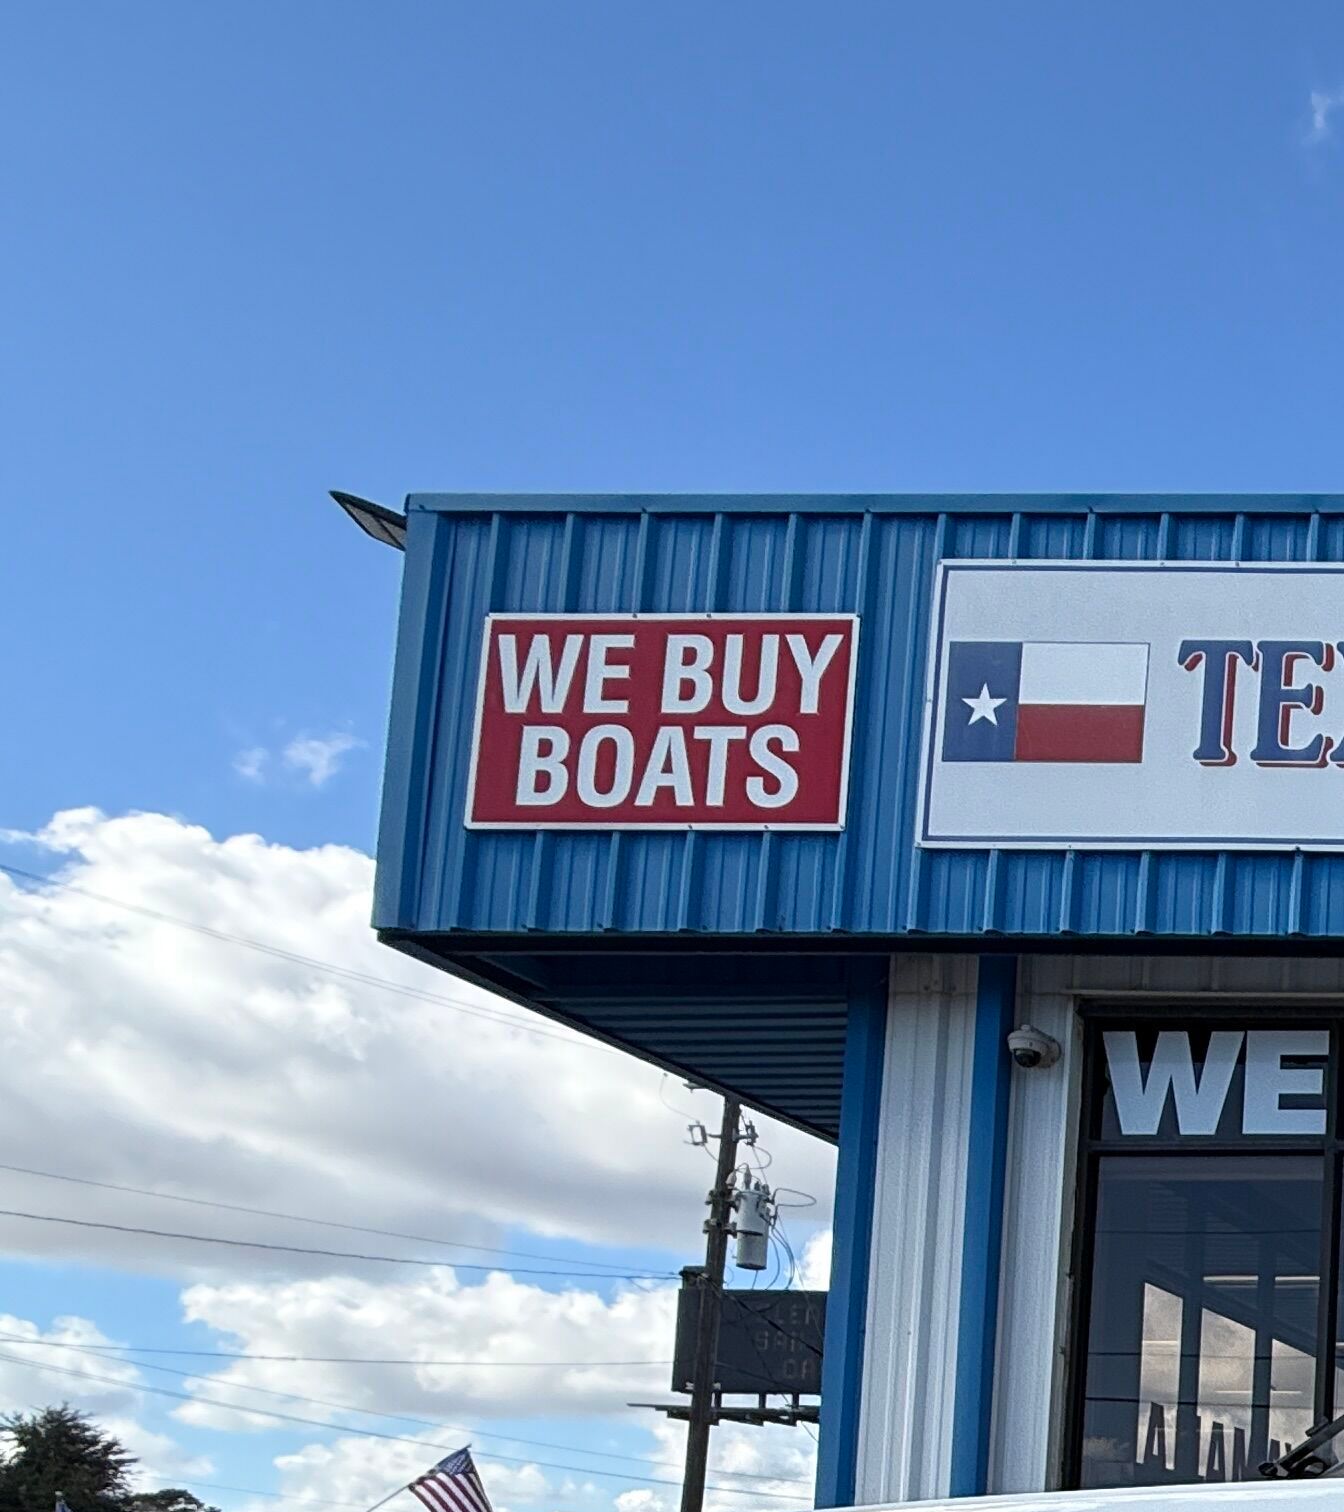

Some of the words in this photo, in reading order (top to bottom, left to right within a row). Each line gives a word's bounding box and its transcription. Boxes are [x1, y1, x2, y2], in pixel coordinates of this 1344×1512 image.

[497, 634, 636, 715] WE
[660, 634, 845, 716] BUY
[515, 724, 801, 808] BOATS
[1102, 1030, 1330, 1136] WE
